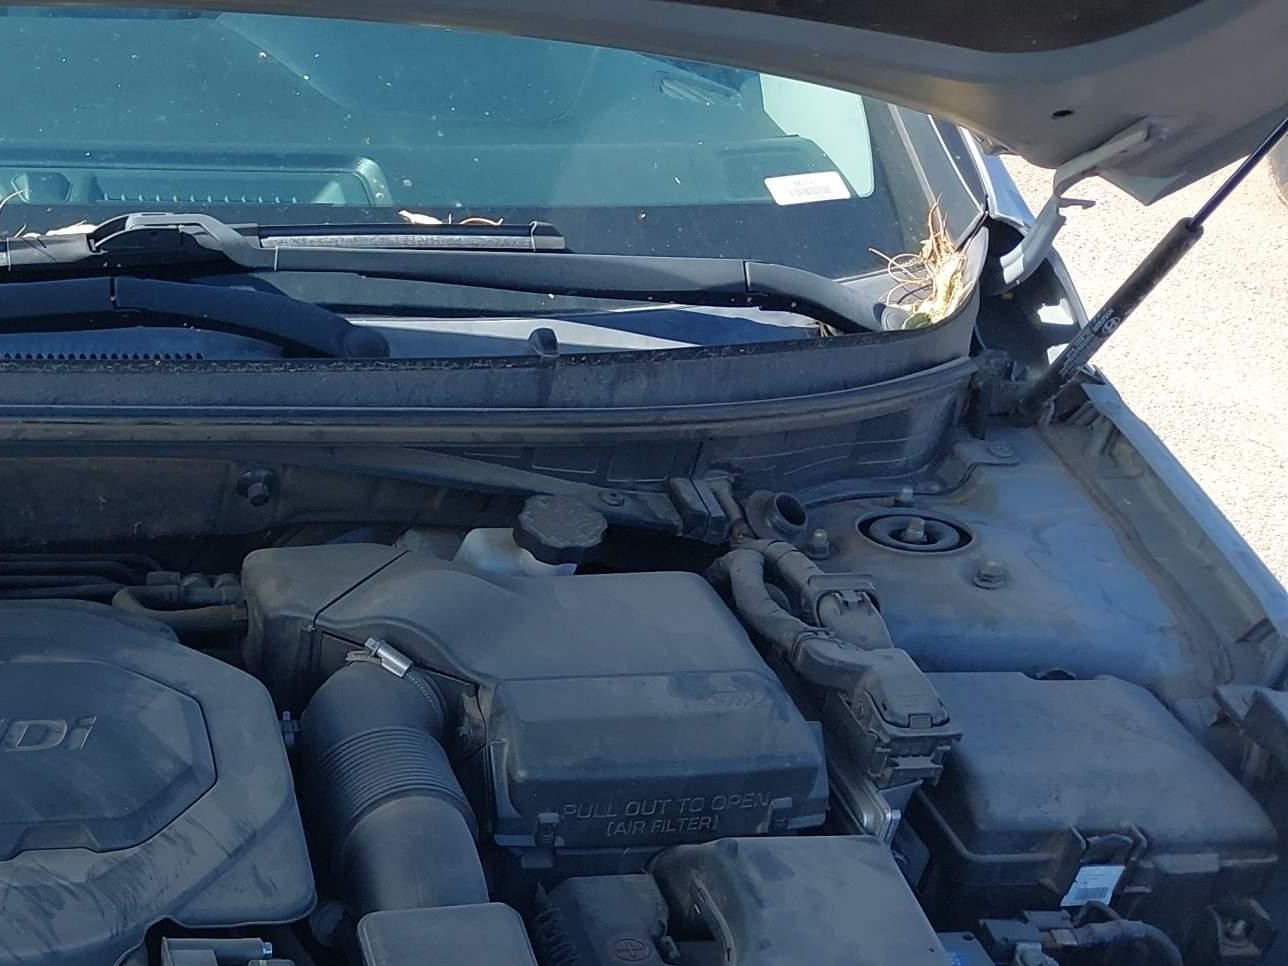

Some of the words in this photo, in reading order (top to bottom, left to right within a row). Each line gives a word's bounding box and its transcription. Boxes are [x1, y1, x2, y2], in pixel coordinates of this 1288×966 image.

[563, 803, 617, 819] PULL
[624, 799, 672, 816] OUT
[680, 797, 705, 814] TO
[711, 792, 770, 811] OPEN
